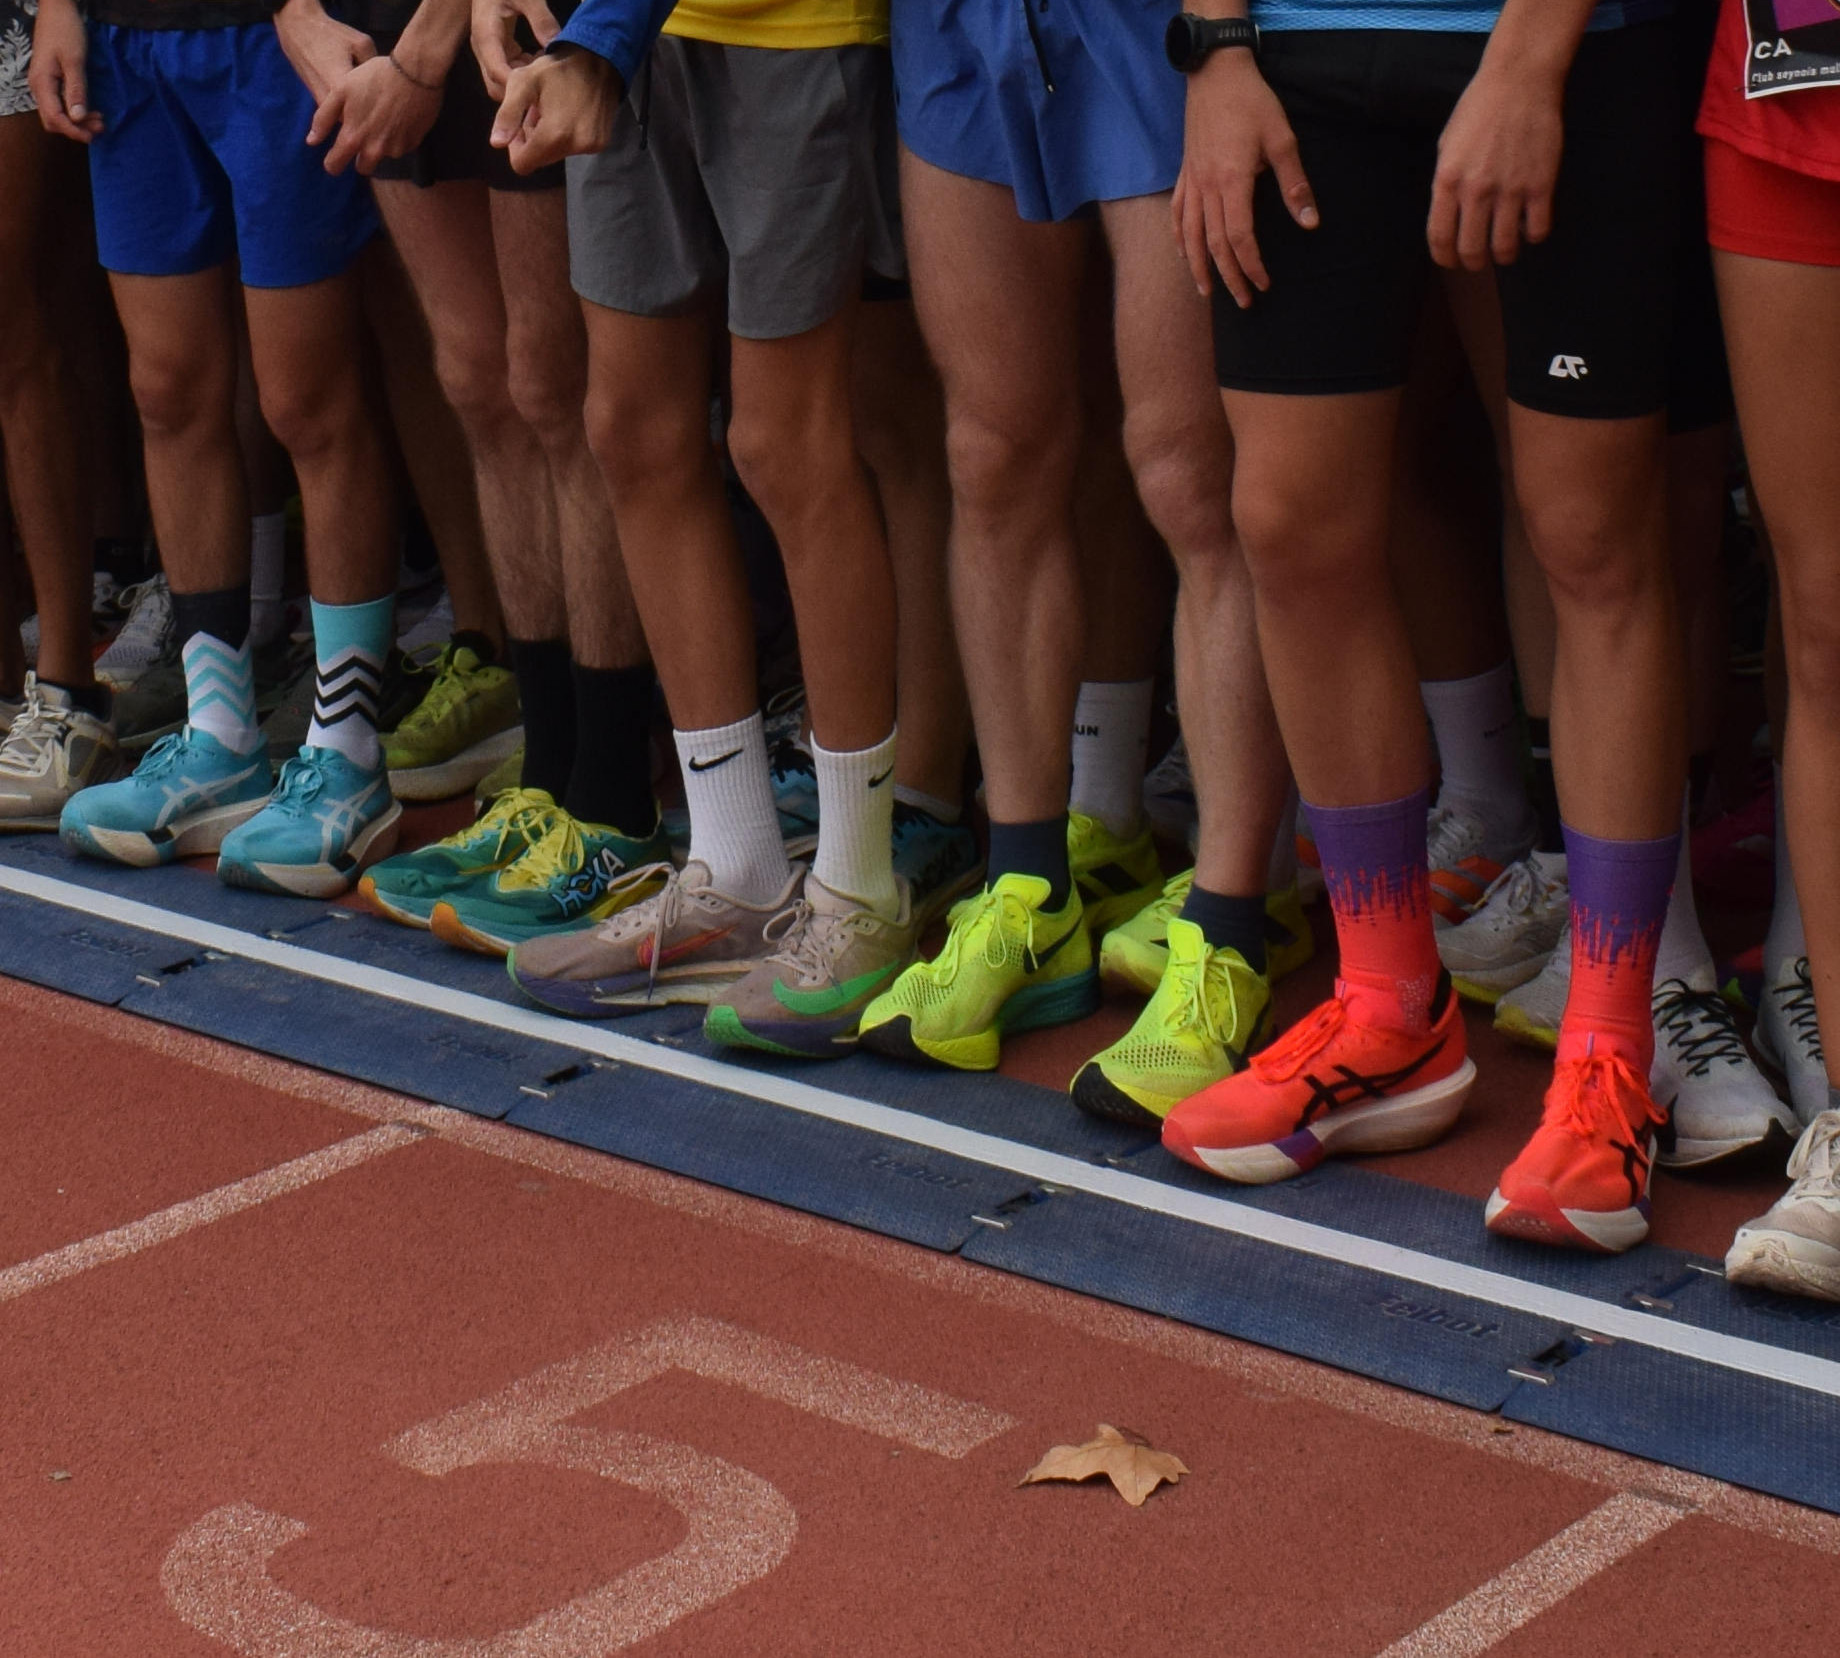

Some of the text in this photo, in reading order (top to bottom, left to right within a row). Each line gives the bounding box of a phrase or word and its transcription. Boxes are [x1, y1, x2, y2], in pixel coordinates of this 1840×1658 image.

[1754, 38, 1792, 59] CA
[551, 846, 626, 918] HOKA
[161, 1312, 1021, 1658] 5
